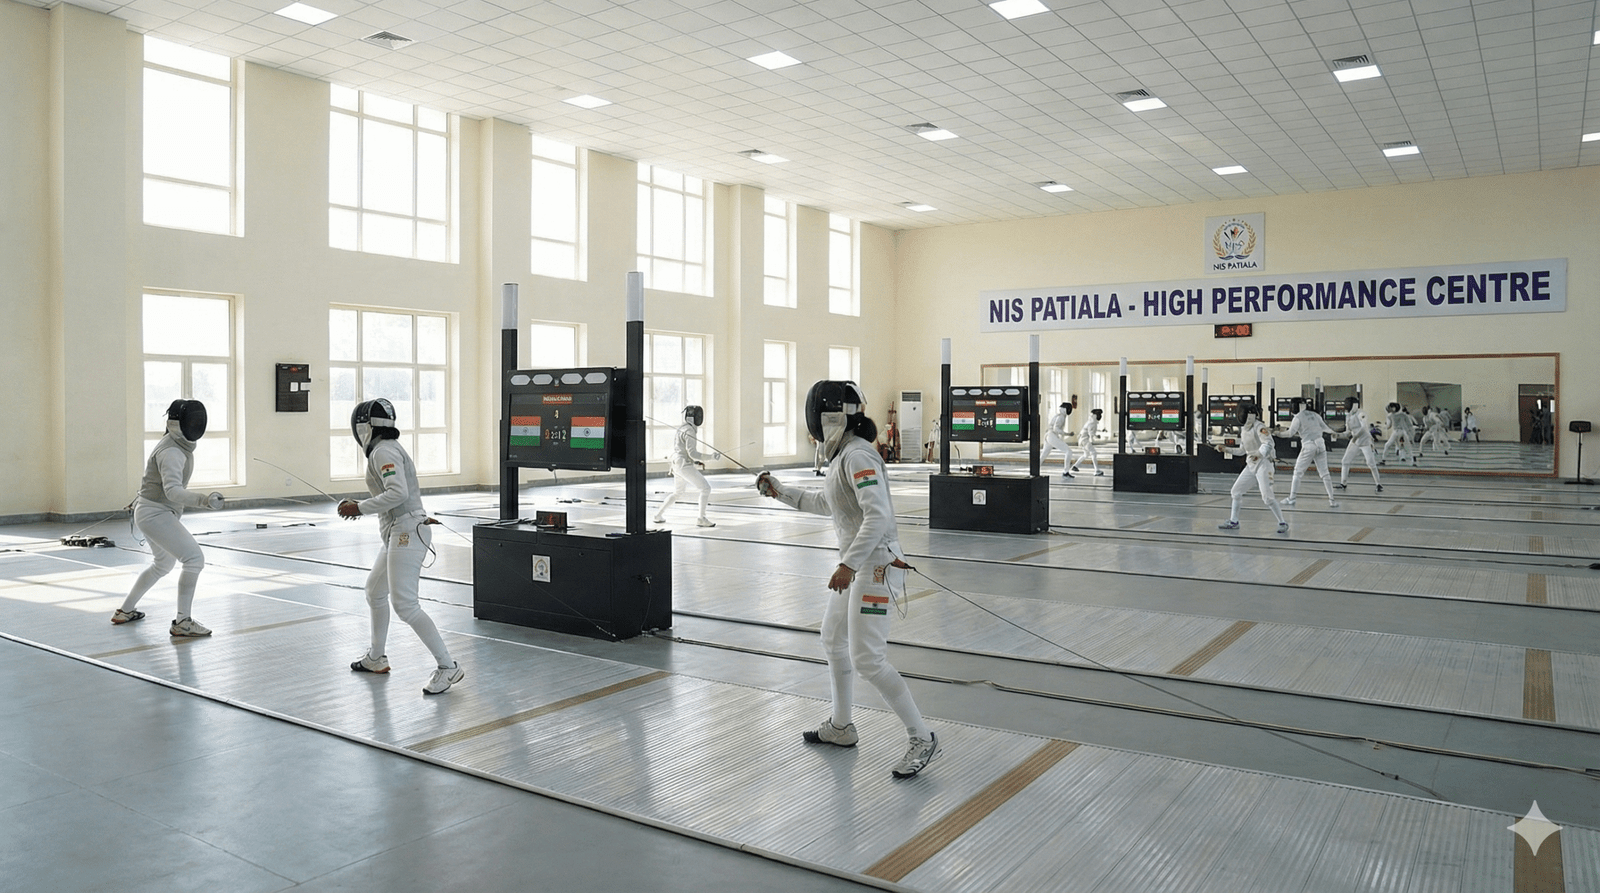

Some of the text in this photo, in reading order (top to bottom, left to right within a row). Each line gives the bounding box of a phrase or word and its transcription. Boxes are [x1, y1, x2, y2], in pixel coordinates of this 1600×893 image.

[1213, 261, 1257, 271] NIS PATIALA
[989, 298, 1024, 323] NIS
[1031, 293, 1122, 321] PATIALA
[1143, 288, 1203, 317] HIGH
[1211, 278, 1416, 314] PERFORMANCE
[1426, 270, 1551, 306] CENTRE
